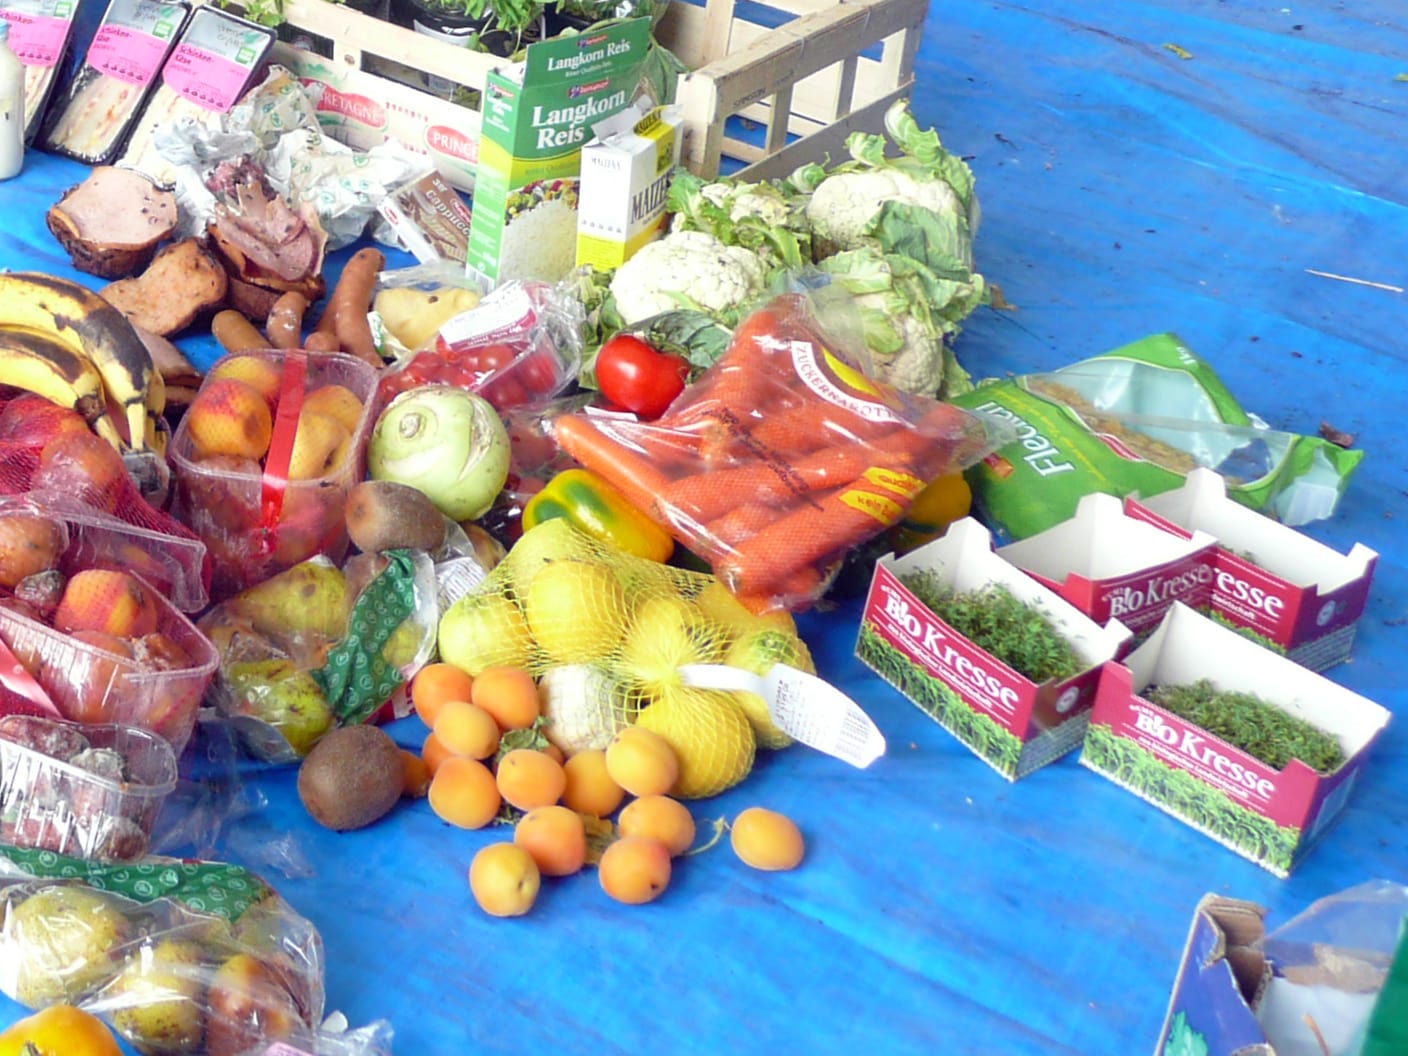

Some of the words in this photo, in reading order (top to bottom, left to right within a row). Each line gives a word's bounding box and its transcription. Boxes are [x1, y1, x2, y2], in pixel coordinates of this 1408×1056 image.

[547, 48, 605, 72] Langkorn
[606, 38, 631, 57] Reis
[531, 89, 625, 128] Langkorn
[536, 124, 585, 150] Reis
[1146, 564, 1213, 606] Kresse
[1214, 567, 1285, 618] esse
[922, 620, 1020, 711] Kresse
[1178, 729, 1277, 800] Kresse
